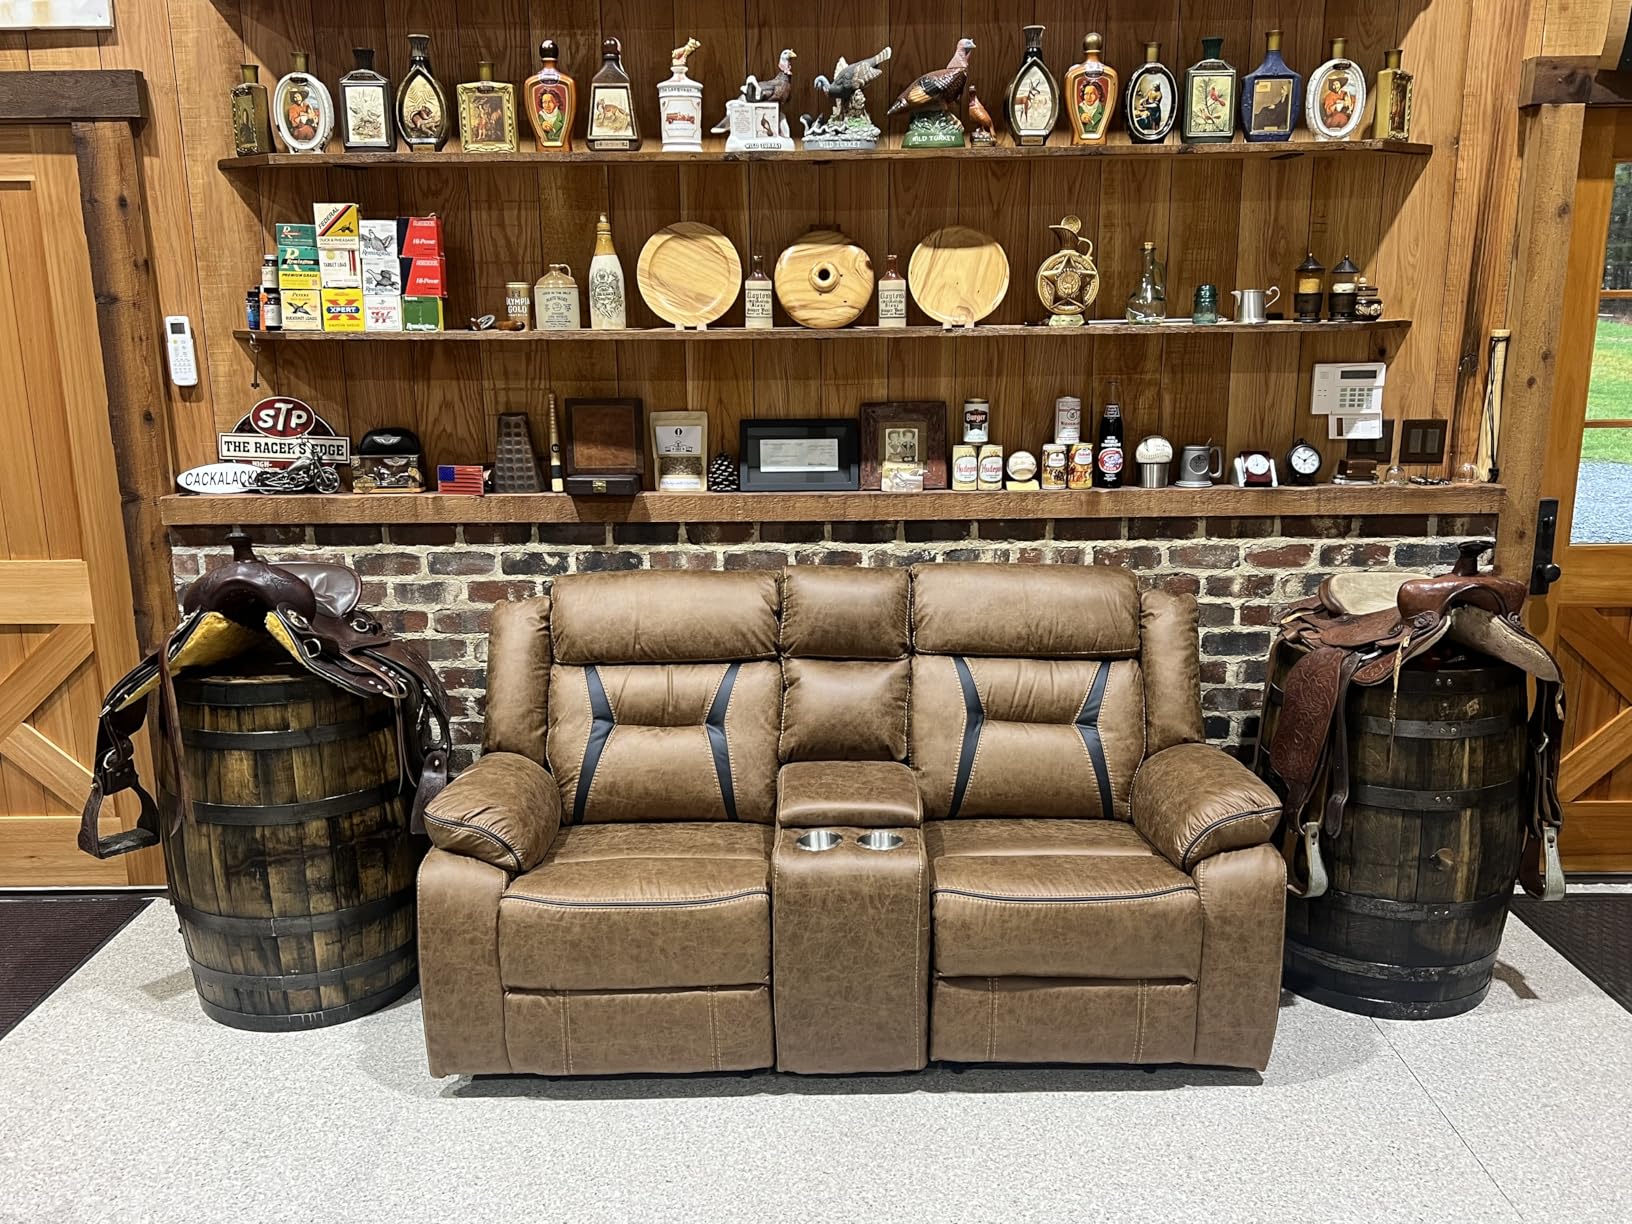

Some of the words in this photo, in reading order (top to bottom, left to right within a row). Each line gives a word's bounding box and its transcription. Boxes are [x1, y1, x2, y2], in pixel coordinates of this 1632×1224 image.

[318, 207, 340, 229] FEDERAL
[507, 306, 527, 314] GOLD
[257, 402, 307, 431] STP
[966, 413, 986, 423] Burger
[224, 441, 250, 453] THE
[254, 442, 306, 455] RACERS
[312, 444, 344, 456] EDGE
